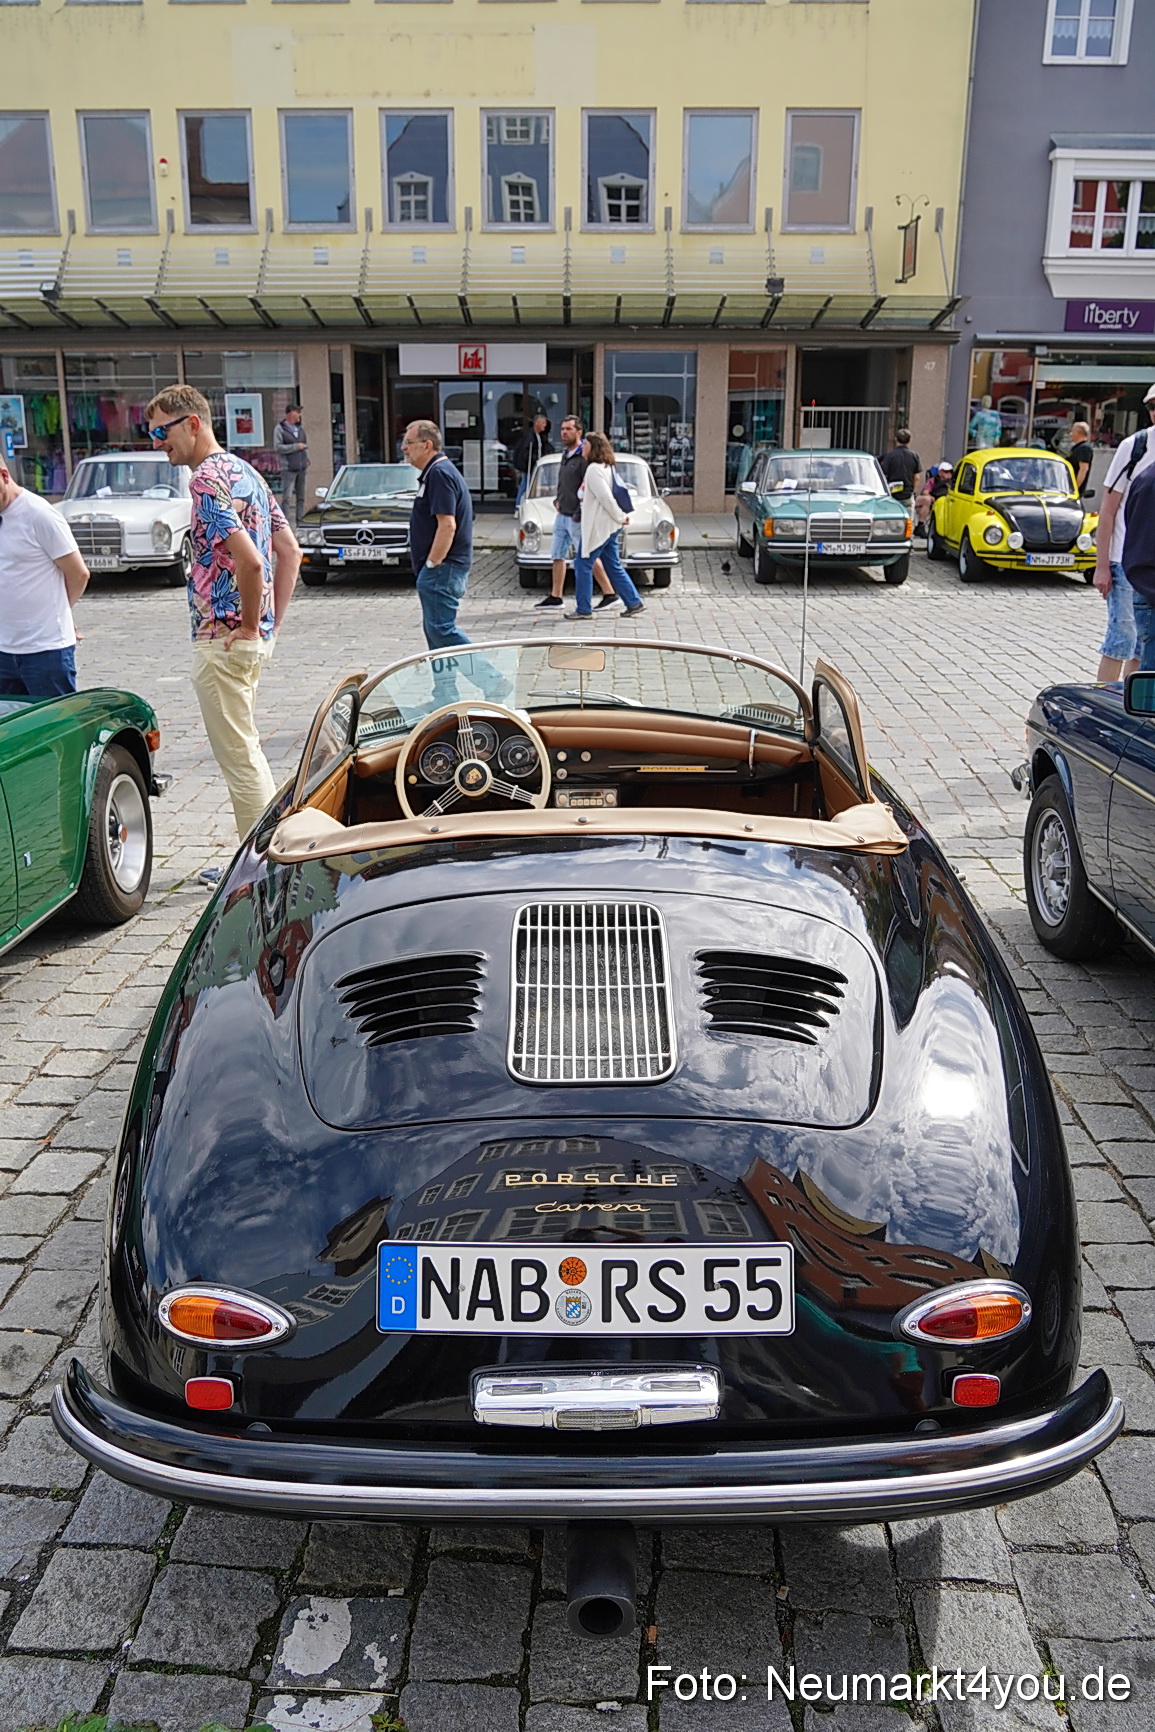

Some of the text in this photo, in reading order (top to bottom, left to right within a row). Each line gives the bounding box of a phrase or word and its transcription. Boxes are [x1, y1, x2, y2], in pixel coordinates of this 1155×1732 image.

[1083, 302, 1140, 328] liberty
[463, 348, 483, 369] kik
[505, 1173, 678, 1187] PORSCHE
[534, 1201, 652, 1213] Carrera
[421, 1256, 784, 1324] NAB RS 55
[391, 1296, 406, 1315] D
